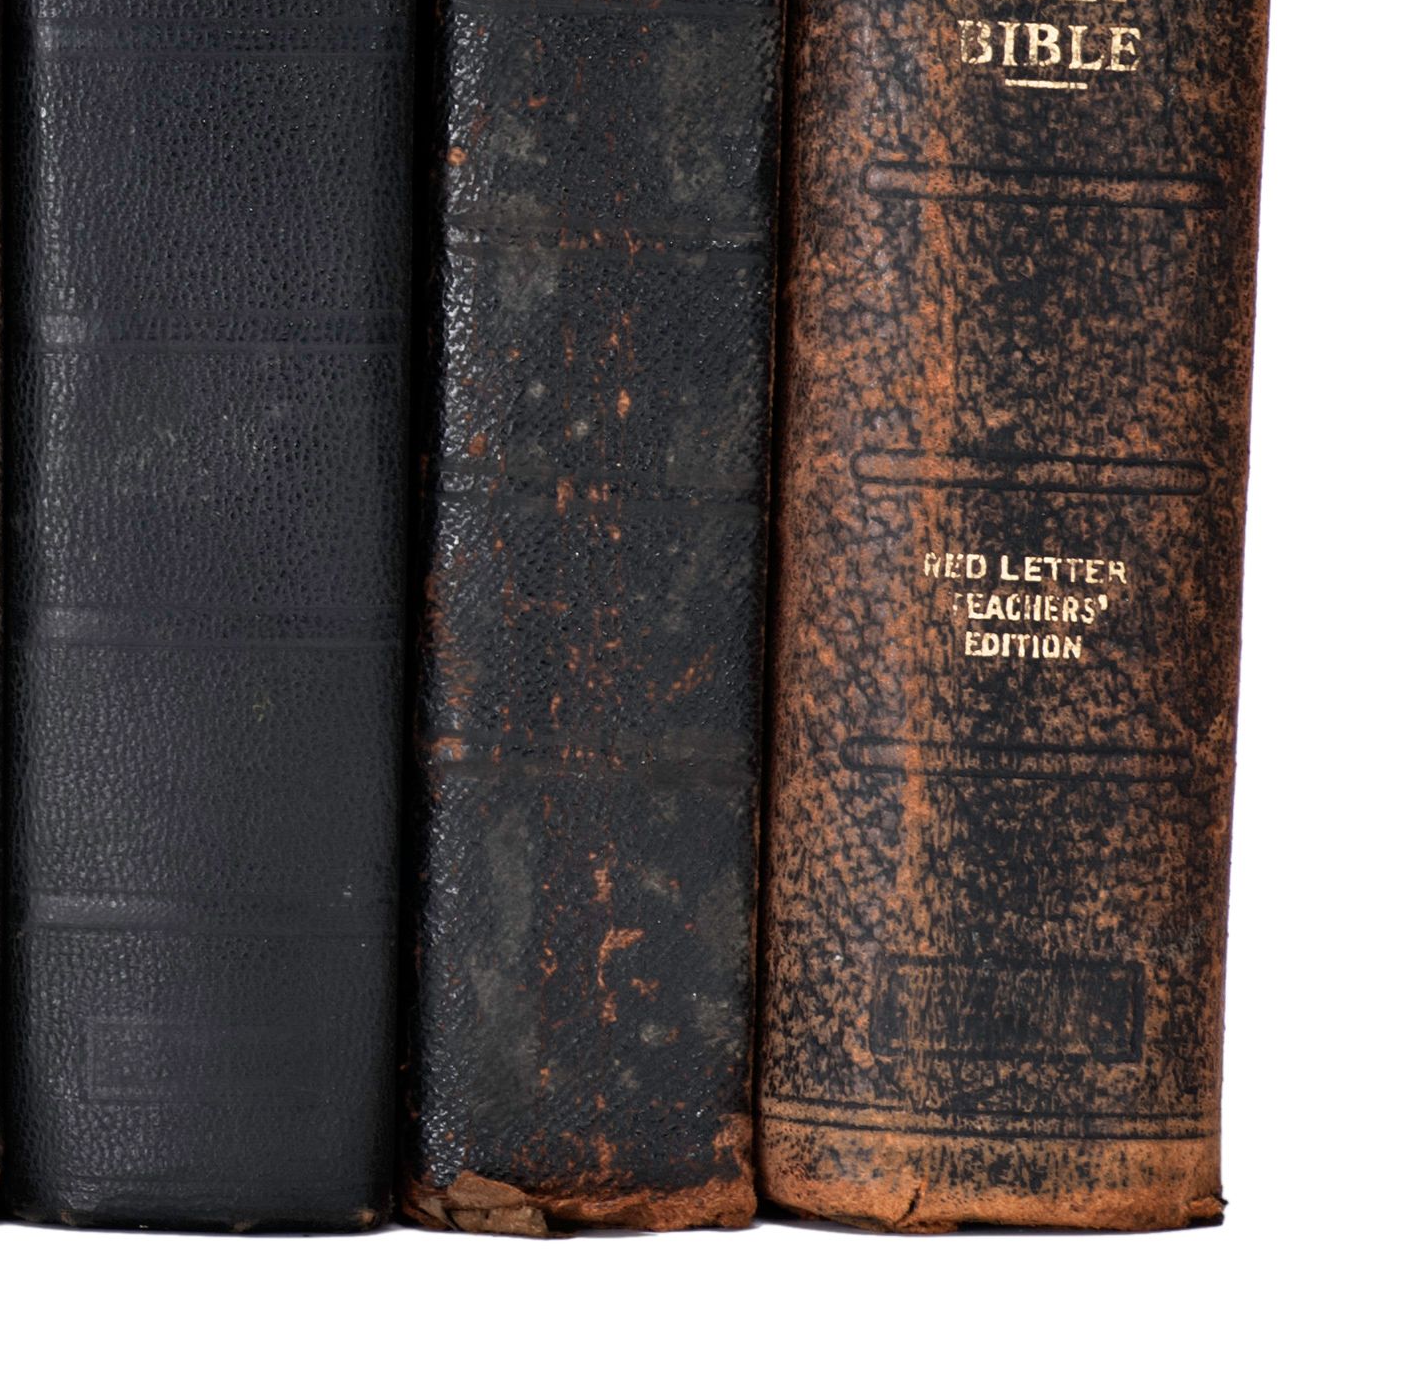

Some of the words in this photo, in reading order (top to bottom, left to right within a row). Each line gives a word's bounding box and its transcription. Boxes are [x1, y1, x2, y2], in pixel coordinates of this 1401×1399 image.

[958, 20, 1142, 71] BIBLE
[922, 552, 986, 580] RED
[1000, 554, 1127, 584] LETTER
[964, 630, 1082, 659] EDITION
